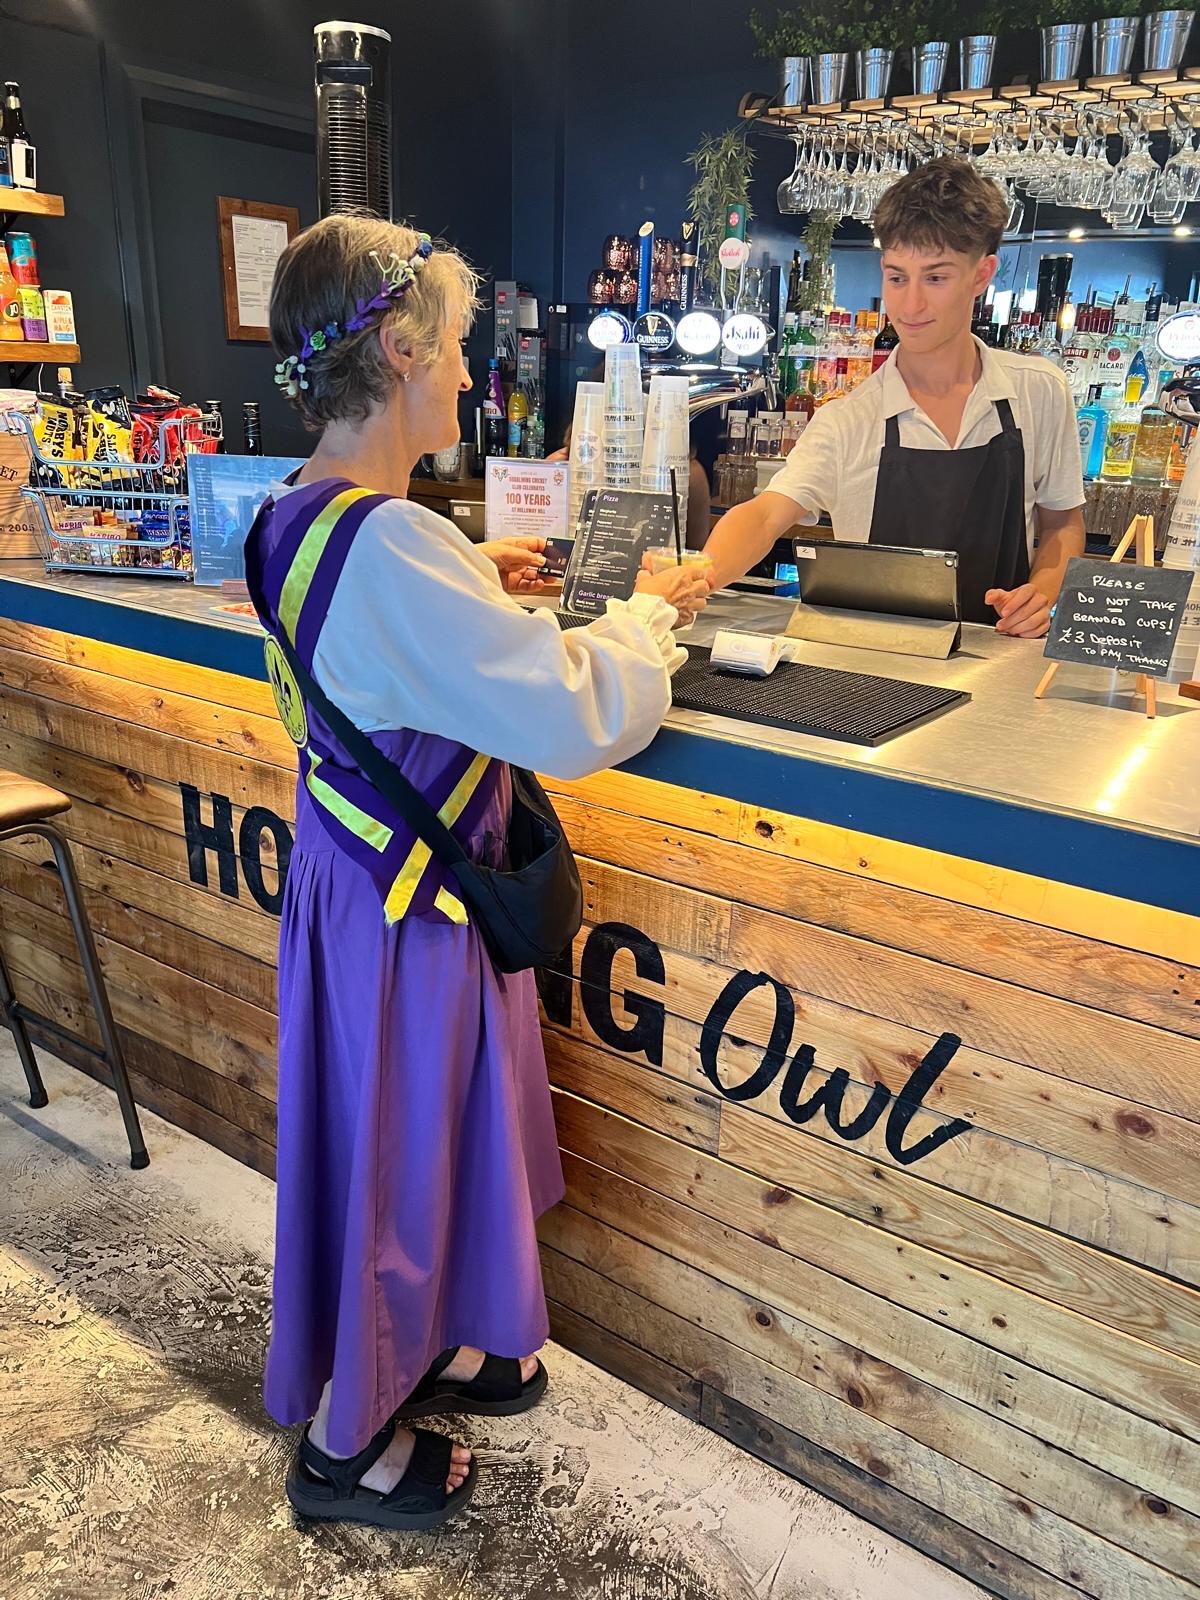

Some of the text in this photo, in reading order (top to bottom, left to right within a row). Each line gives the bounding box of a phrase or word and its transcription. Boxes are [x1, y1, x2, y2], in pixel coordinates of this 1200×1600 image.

[680, 274, 688, 310] GUINNESS
[636, 333, 669, 344] GUINNESS
[726, 326, 760, 340] Asahi
[41, 416, 57, 444] NUTS
[505, 492, 551, 506] 100 YEARS
[603, 494, 619, 502] Pizza
[58, 521, 89, 529] HARIBO
[1092, 575, 1146, 591] PLEASE
[578, 589, 596, 598] Garlic
[1105, 597, 1131, 607] NOT
[1139, 600, 1177, 612] TAKE
[1072, 612, 1174, 636] BRANDED CUPS!
[1058, 627, 1085, 643] £3
[1125, 654, 1169, 667] THANKS
[698, 968, 974, 1166] Owl
